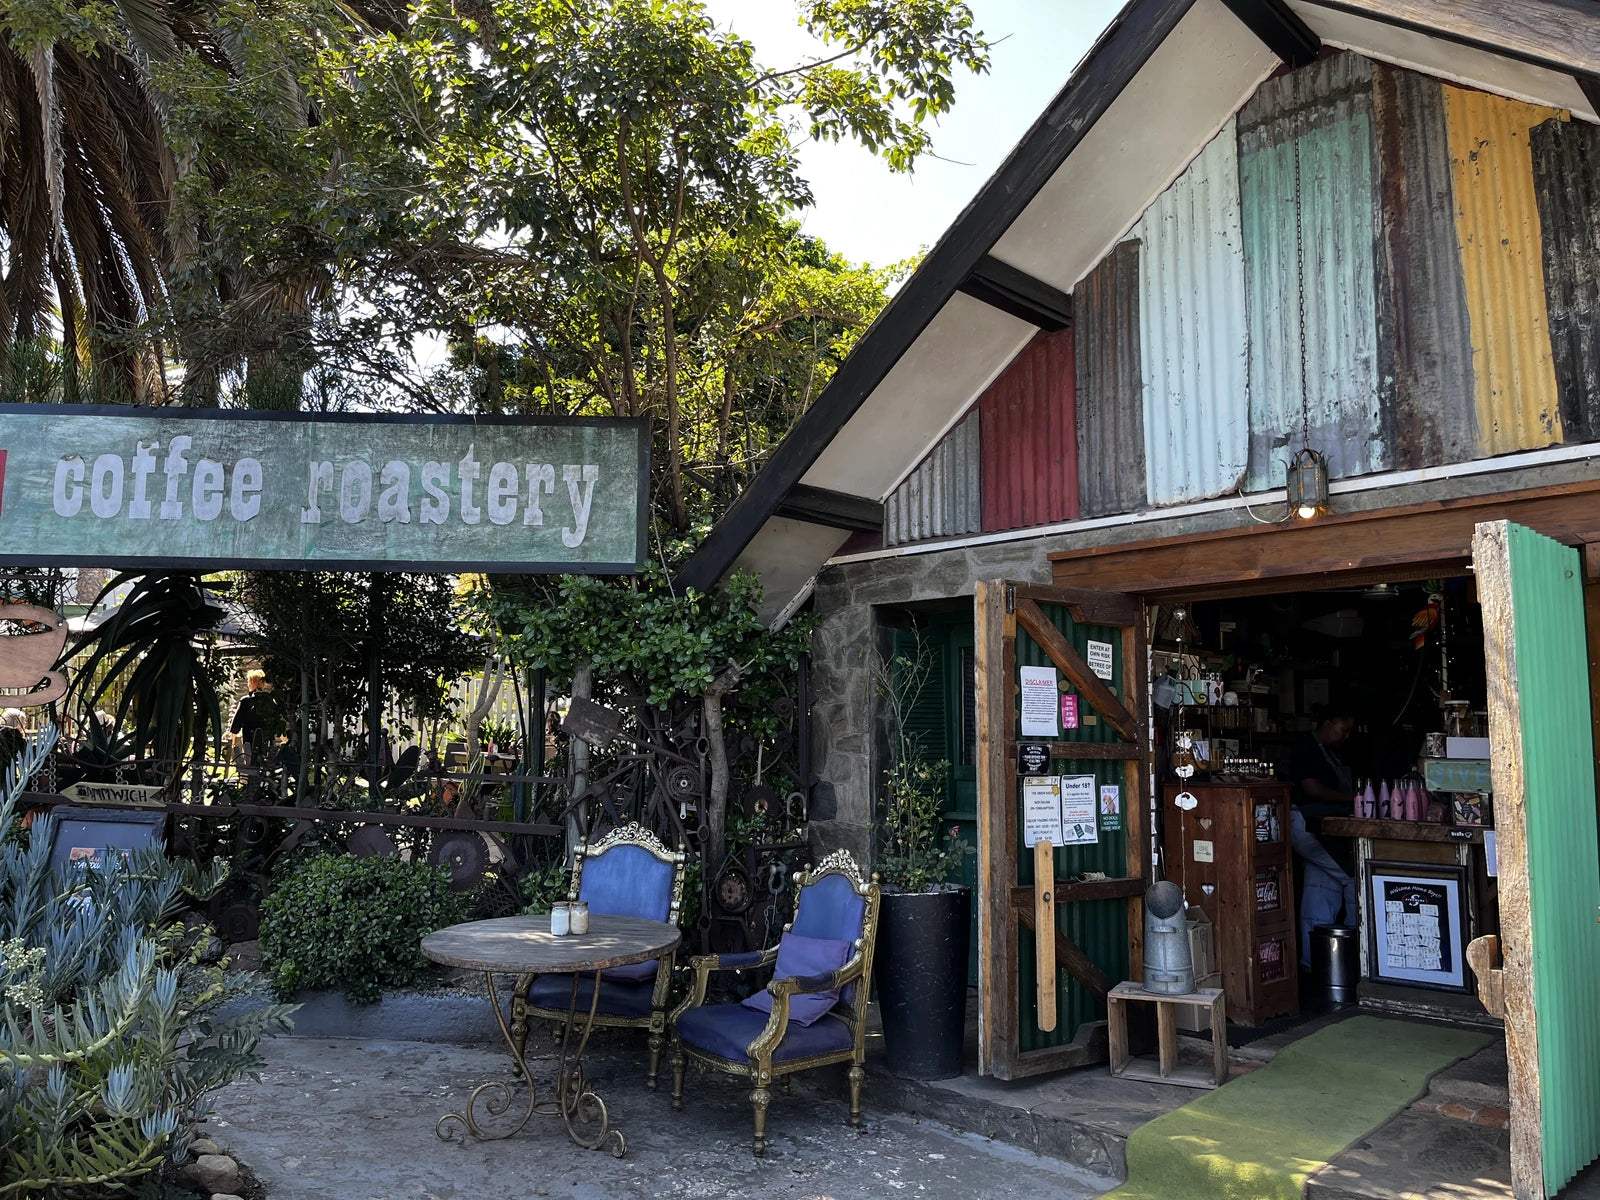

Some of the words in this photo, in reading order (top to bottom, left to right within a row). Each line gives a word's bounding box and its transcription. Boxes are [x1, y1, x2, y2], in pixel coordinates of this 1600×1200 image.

[53, 435, 263, 522] coffee
[301, 443, 599, 548] roastery
[1090, 644, 1104, 652] ENTER
